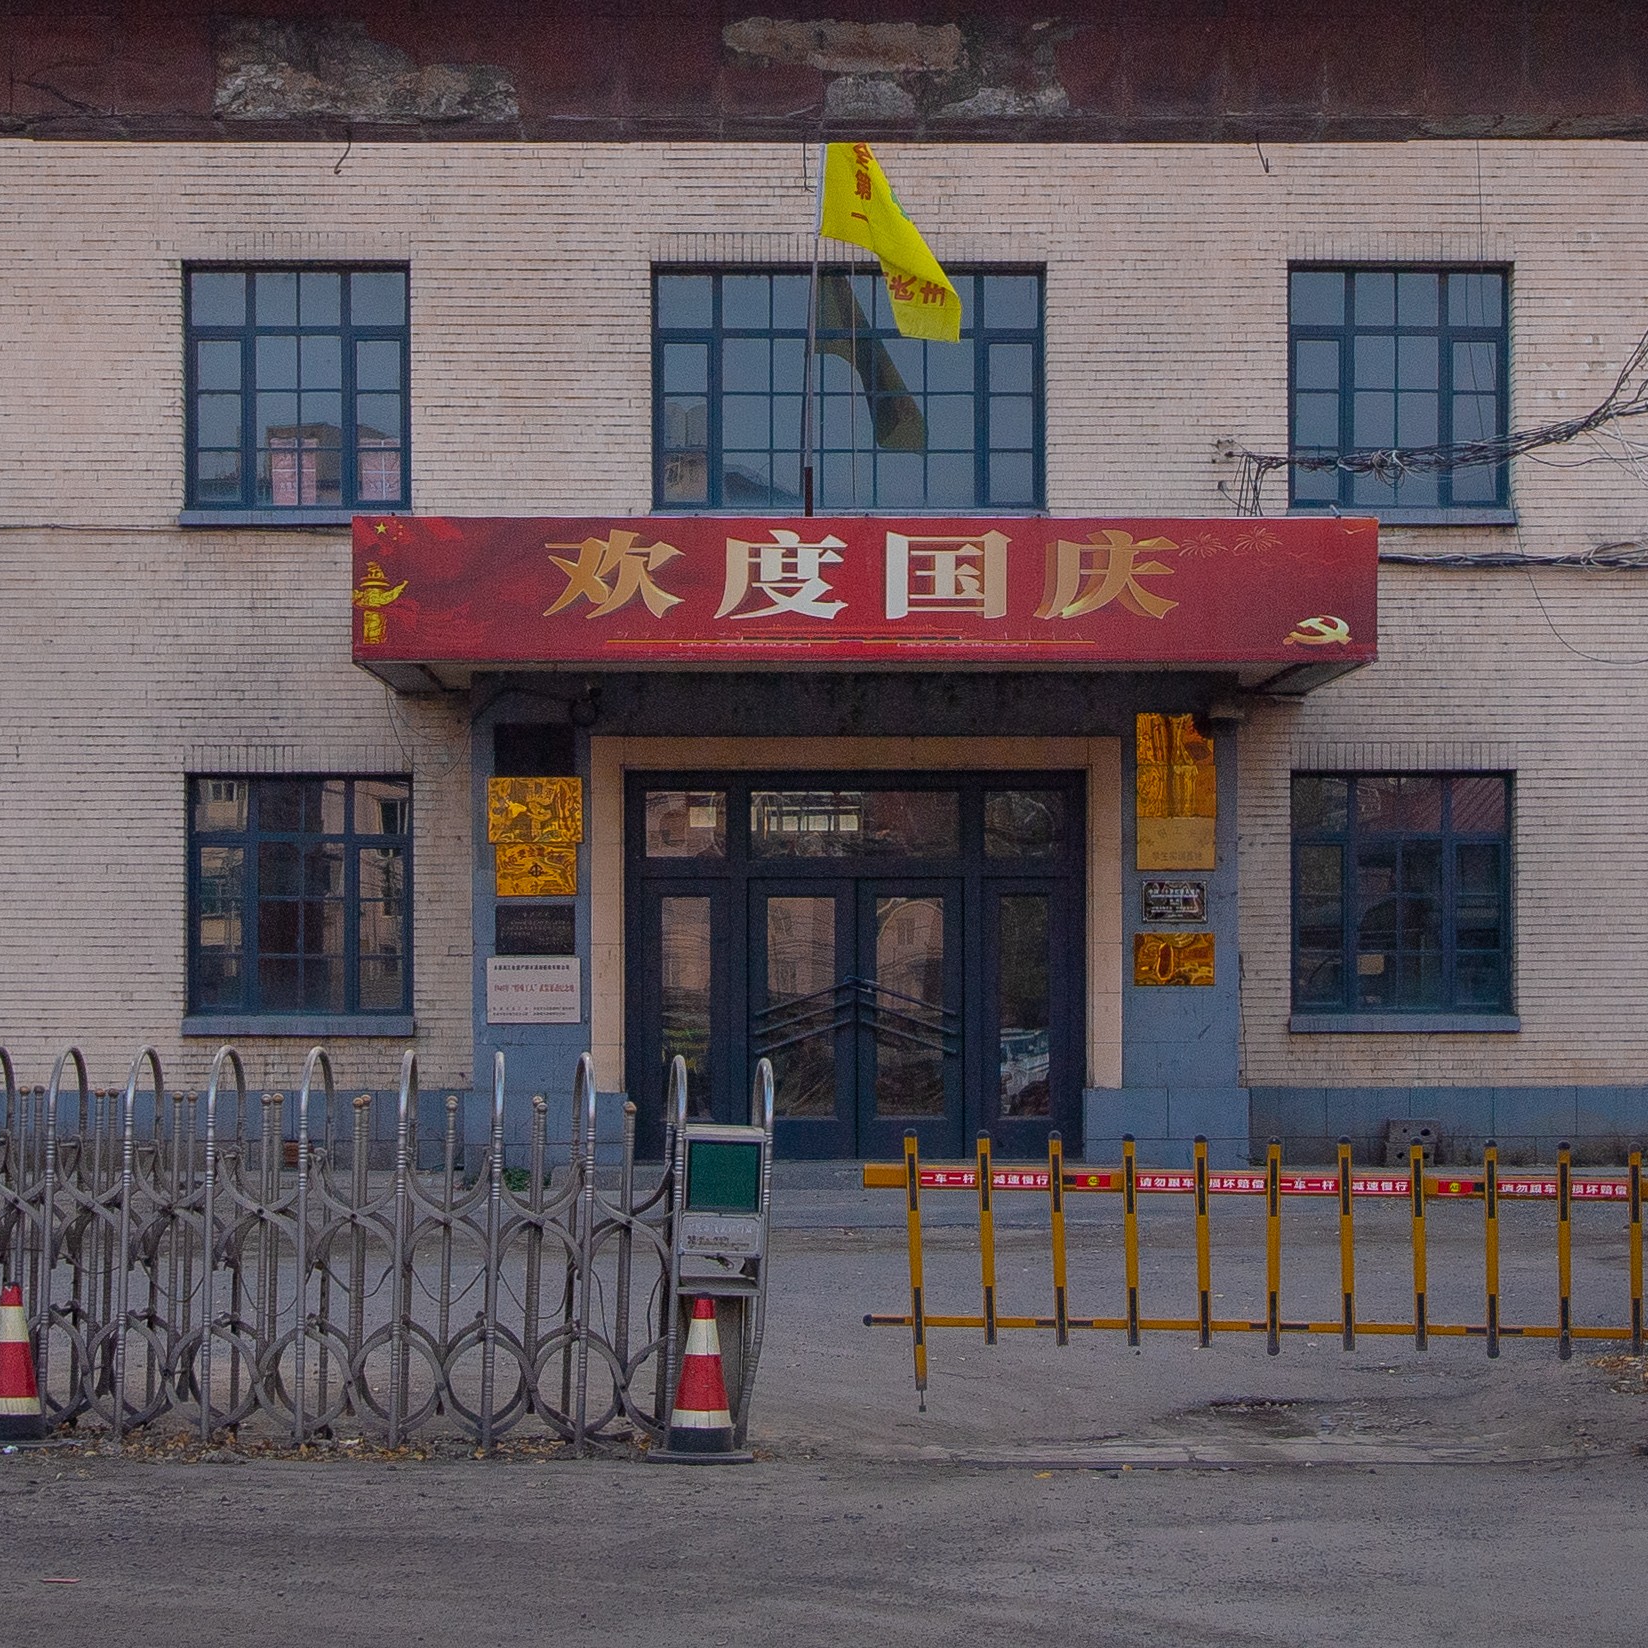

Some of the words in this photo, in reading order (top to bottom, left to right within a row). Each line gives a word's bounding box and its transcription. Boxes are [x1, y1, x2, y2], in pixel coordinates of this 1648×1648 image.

[543, 529, 1180, 621] 欢度国庆
[921, 1173, 976, 1185] 一车一杆
[993, 1174, 1049, 1186] 减速慢行
[1139, 1176, 1194, 1188] 请勿跟车
[1209, 1178, 1265, 1189] 损坏赔偿
[1281, 1177, 1335, 1190] 一车一杆
[1352, 1180, 1408, 1192] 减速慢行
[1571, 1184, 1627, 1195] 损坏赔偿
